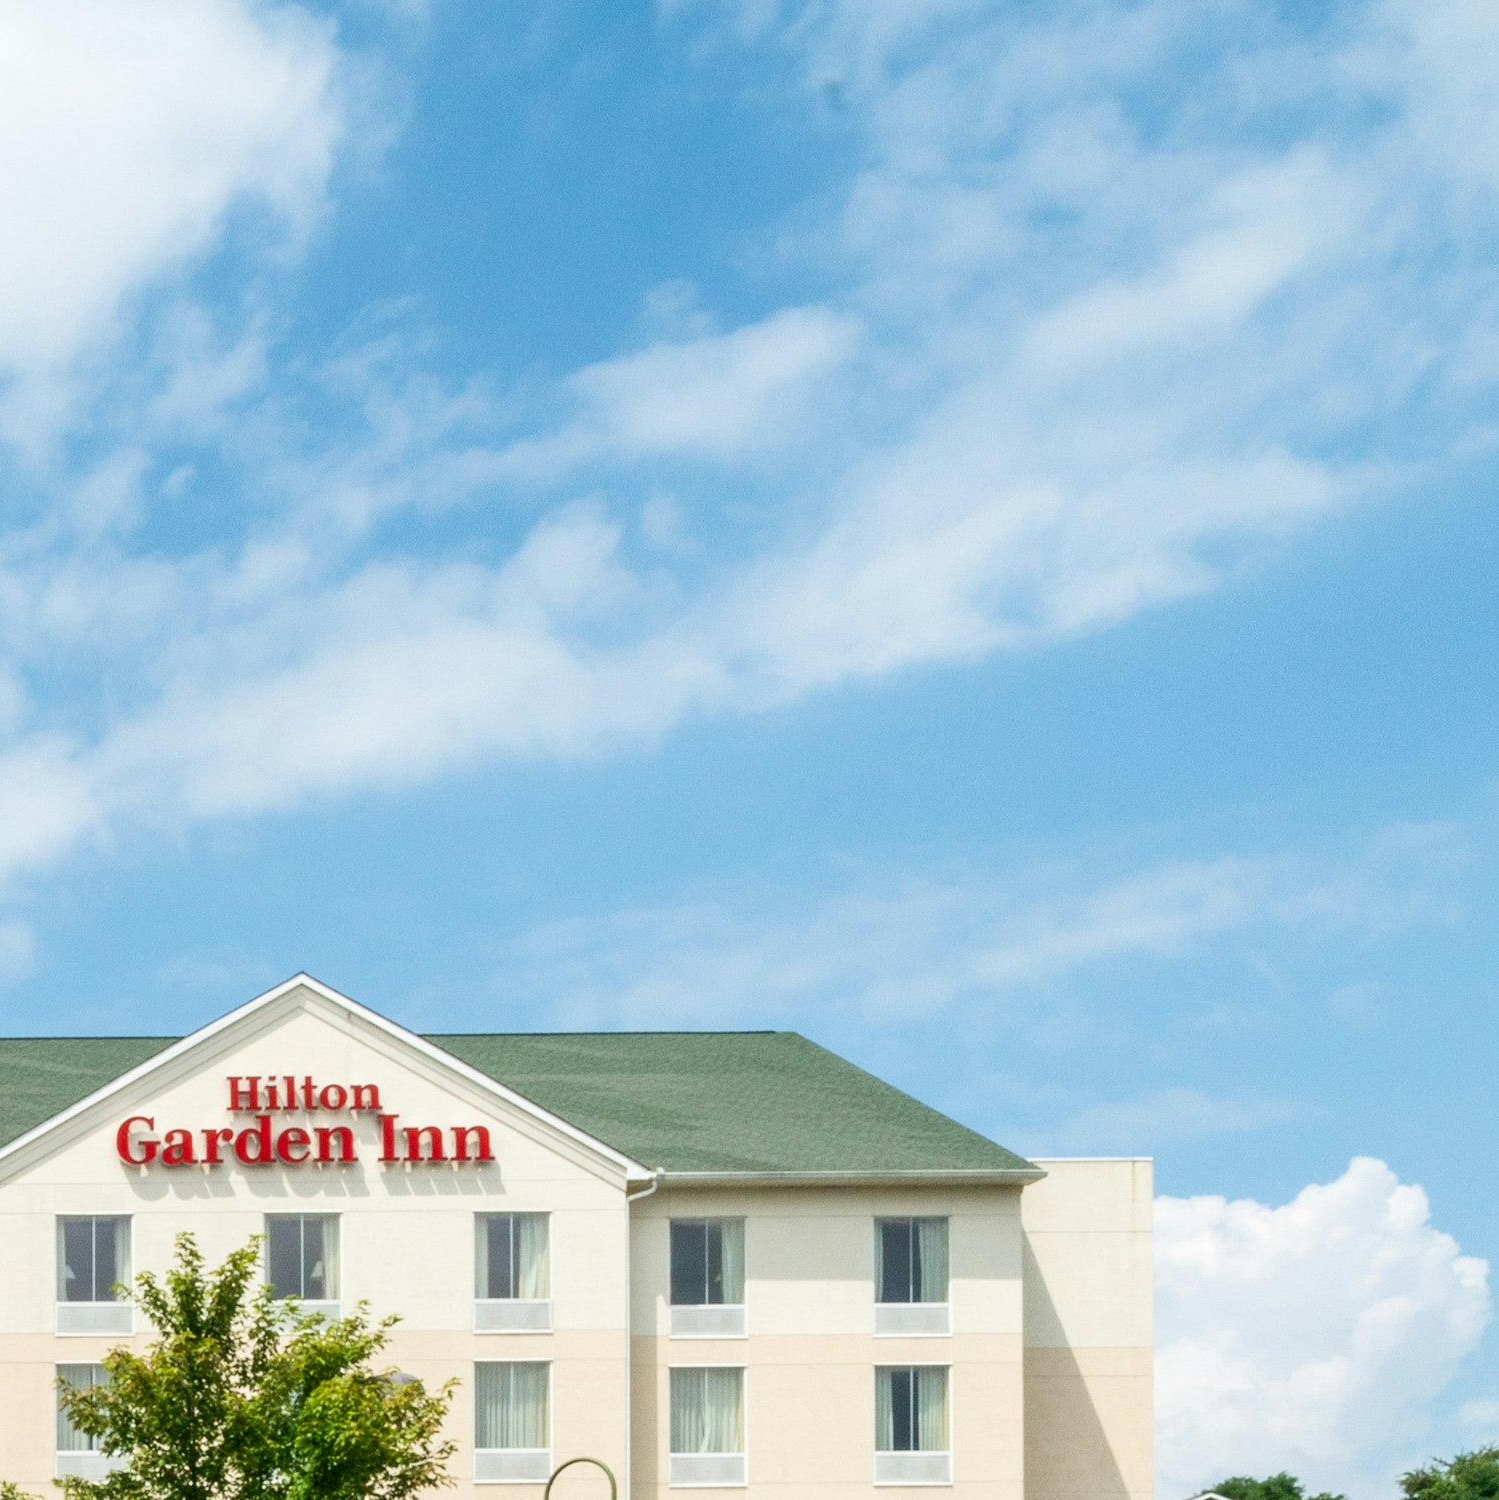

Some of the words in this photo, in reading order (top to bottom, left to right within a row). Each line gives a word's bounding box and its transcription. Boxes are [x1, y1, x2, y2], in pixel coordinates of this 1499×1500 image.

[226, 1075, 383, 1111] Hilton
[116, 1115, 359, 1166] Garden
[378, 1114, 495, 1163] Inn
